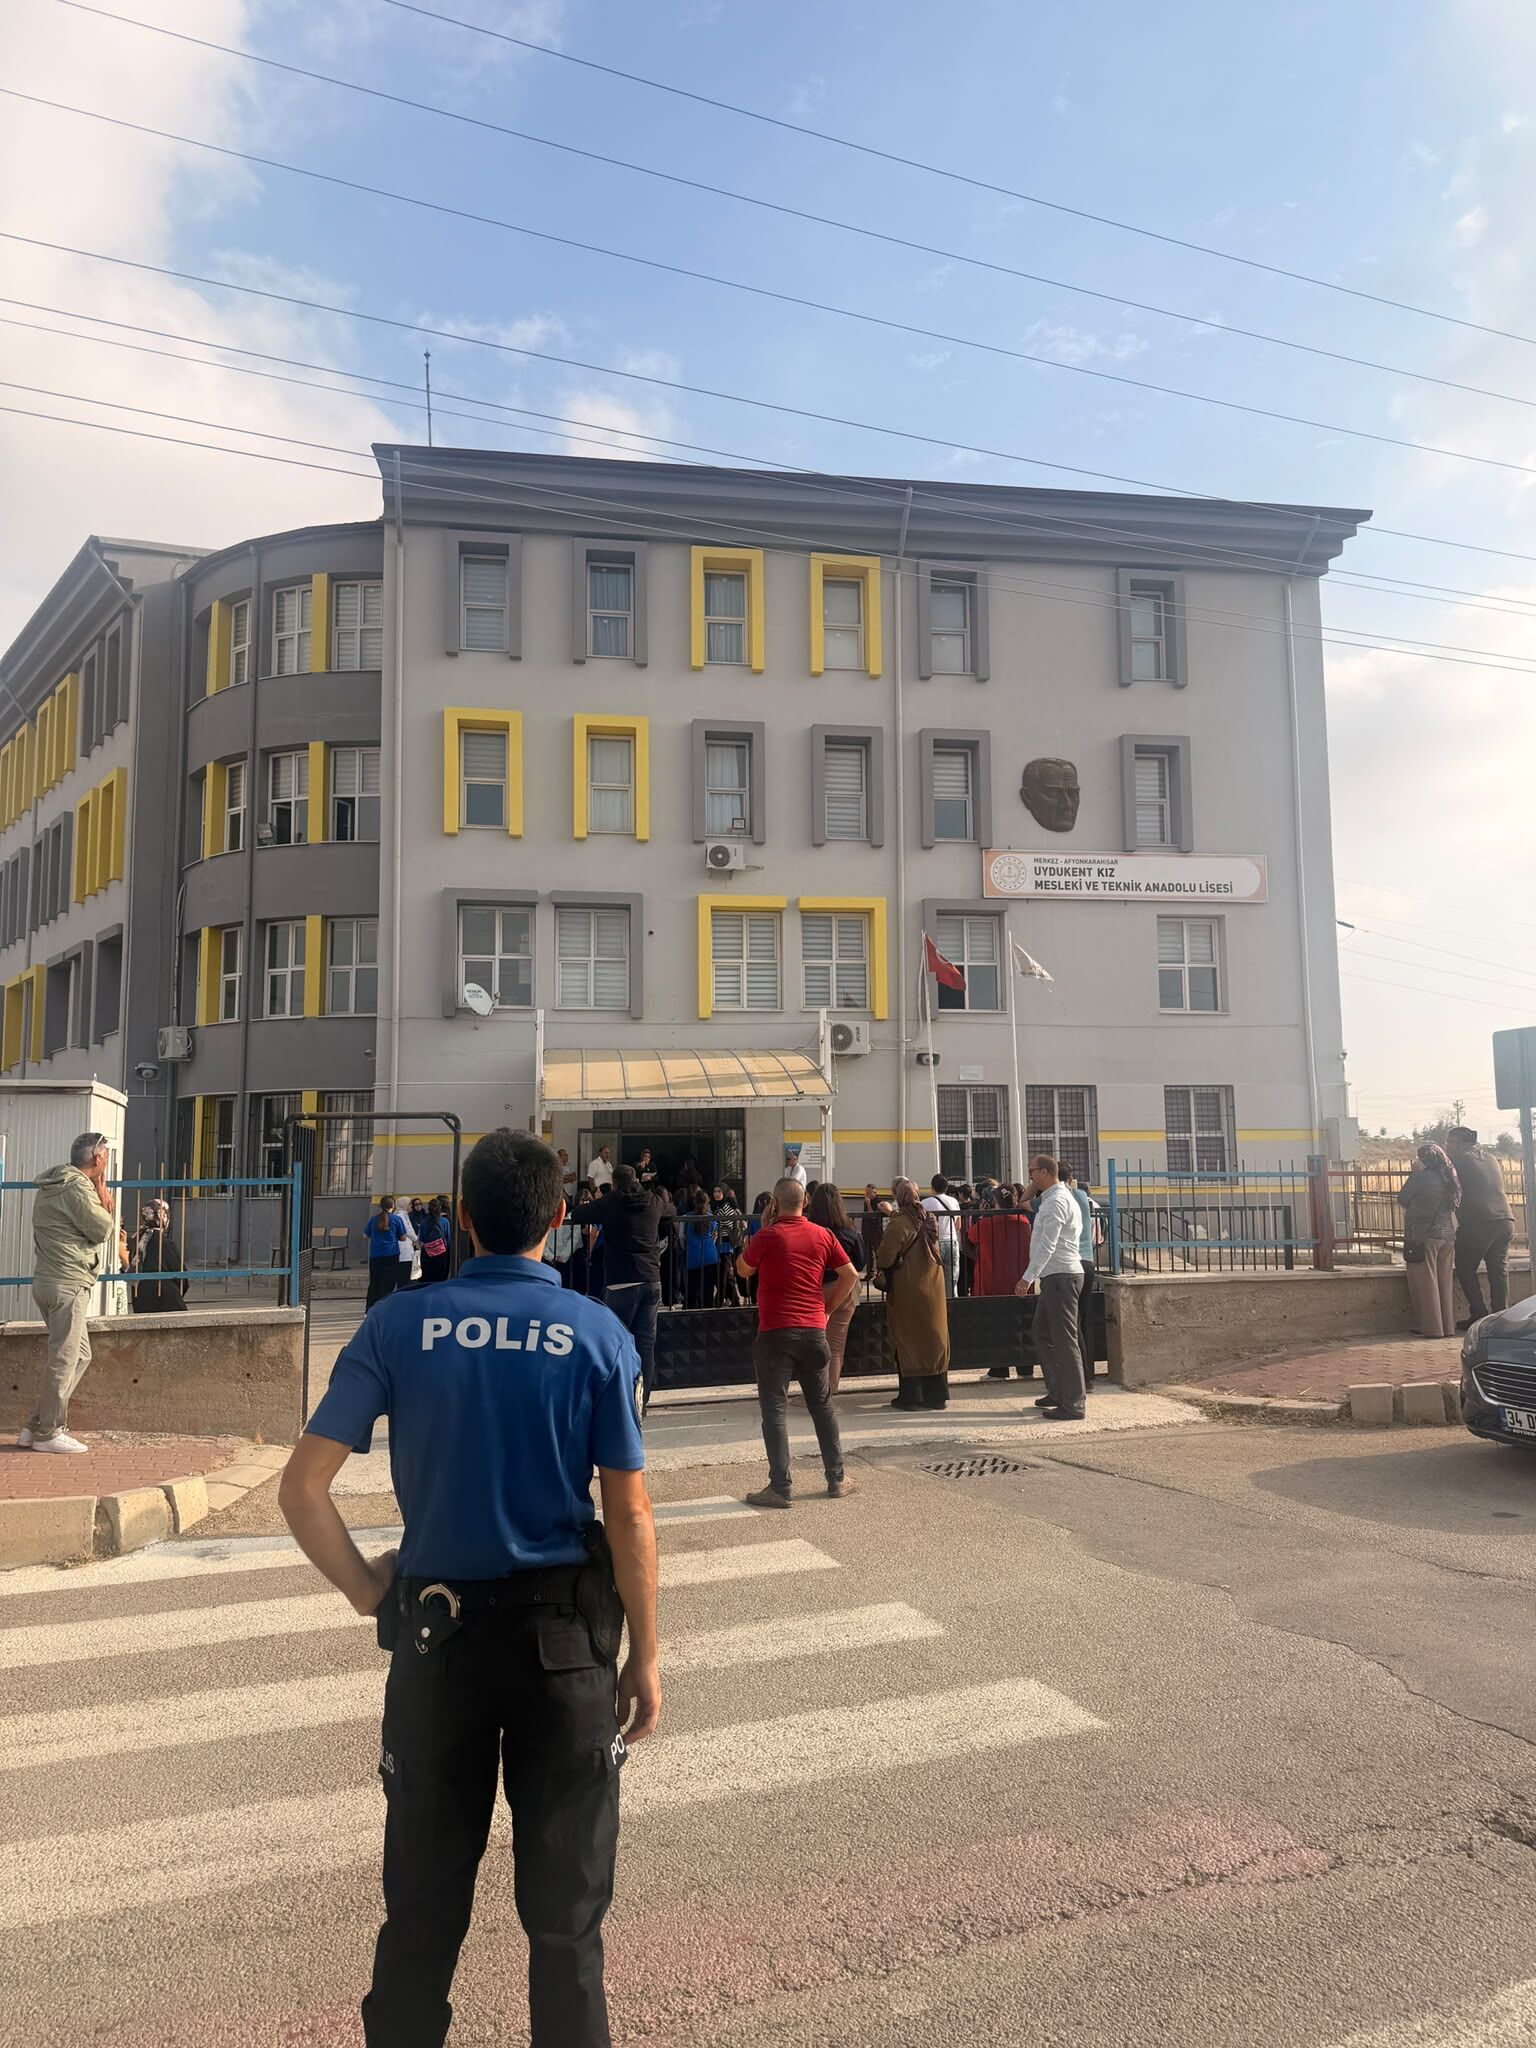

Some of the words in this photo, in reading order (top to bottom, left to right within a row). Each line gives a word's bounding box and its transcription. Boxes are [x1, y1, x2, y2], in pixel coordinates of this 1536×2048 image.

[1034, 866, 1093, 877] UYDUKENT
[1097, 868, 1115, 878] KIZ
[1034, 878, 1082, 890] MESLEKİ
[1085, 881, 1099, 891] VE
[1101, 880, 1142, 892] TEKNİK
[1144, 882, 1196, 893] ANADOLU
[1199, 880, 1233, 893] LİSESİ
[1507, 1411, 1523, 1427] 34
